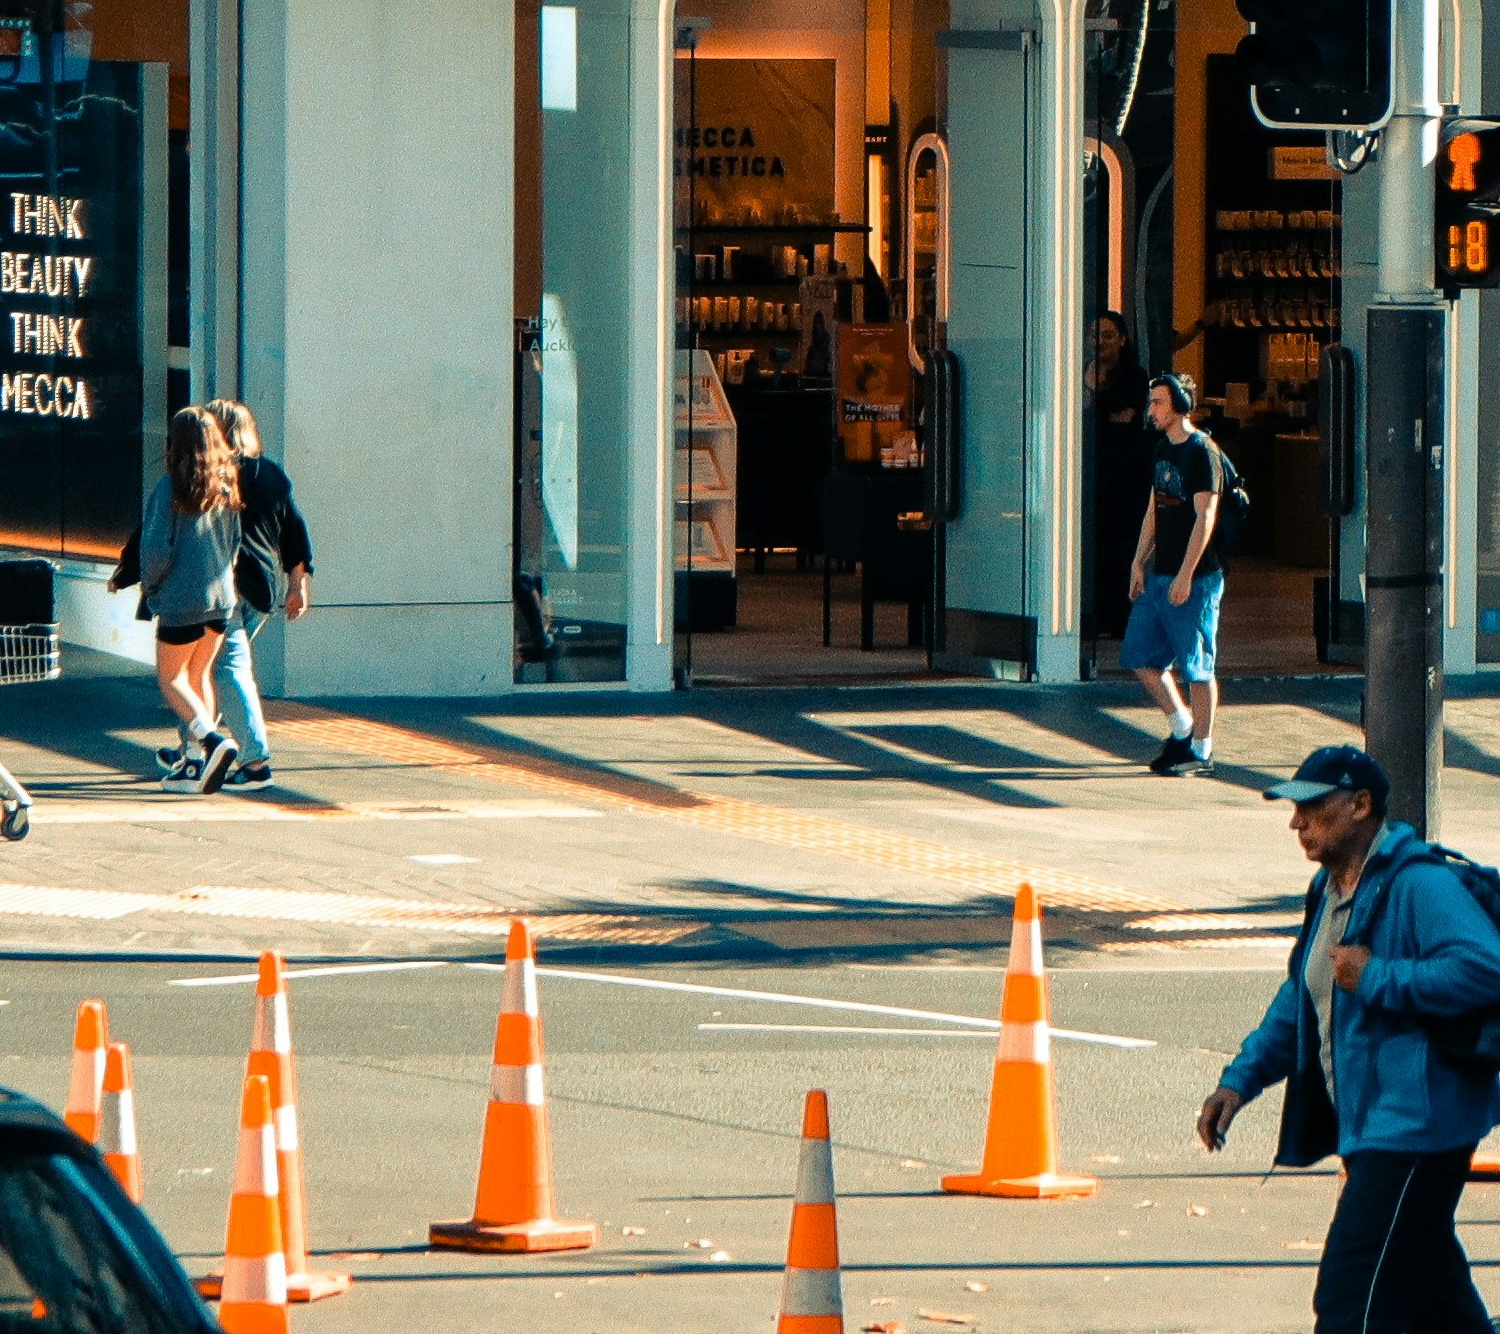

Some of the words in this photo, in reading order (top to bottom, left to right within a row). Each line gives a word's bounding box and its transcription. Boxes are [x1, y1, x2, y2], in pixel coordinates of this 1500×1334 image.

[10, 192, 84, 239] THINK
[0, 250, 92, 299] BEAUTY
[10, 311, 84, 358] THINK
[0, 372, 91, 421] MECCA
